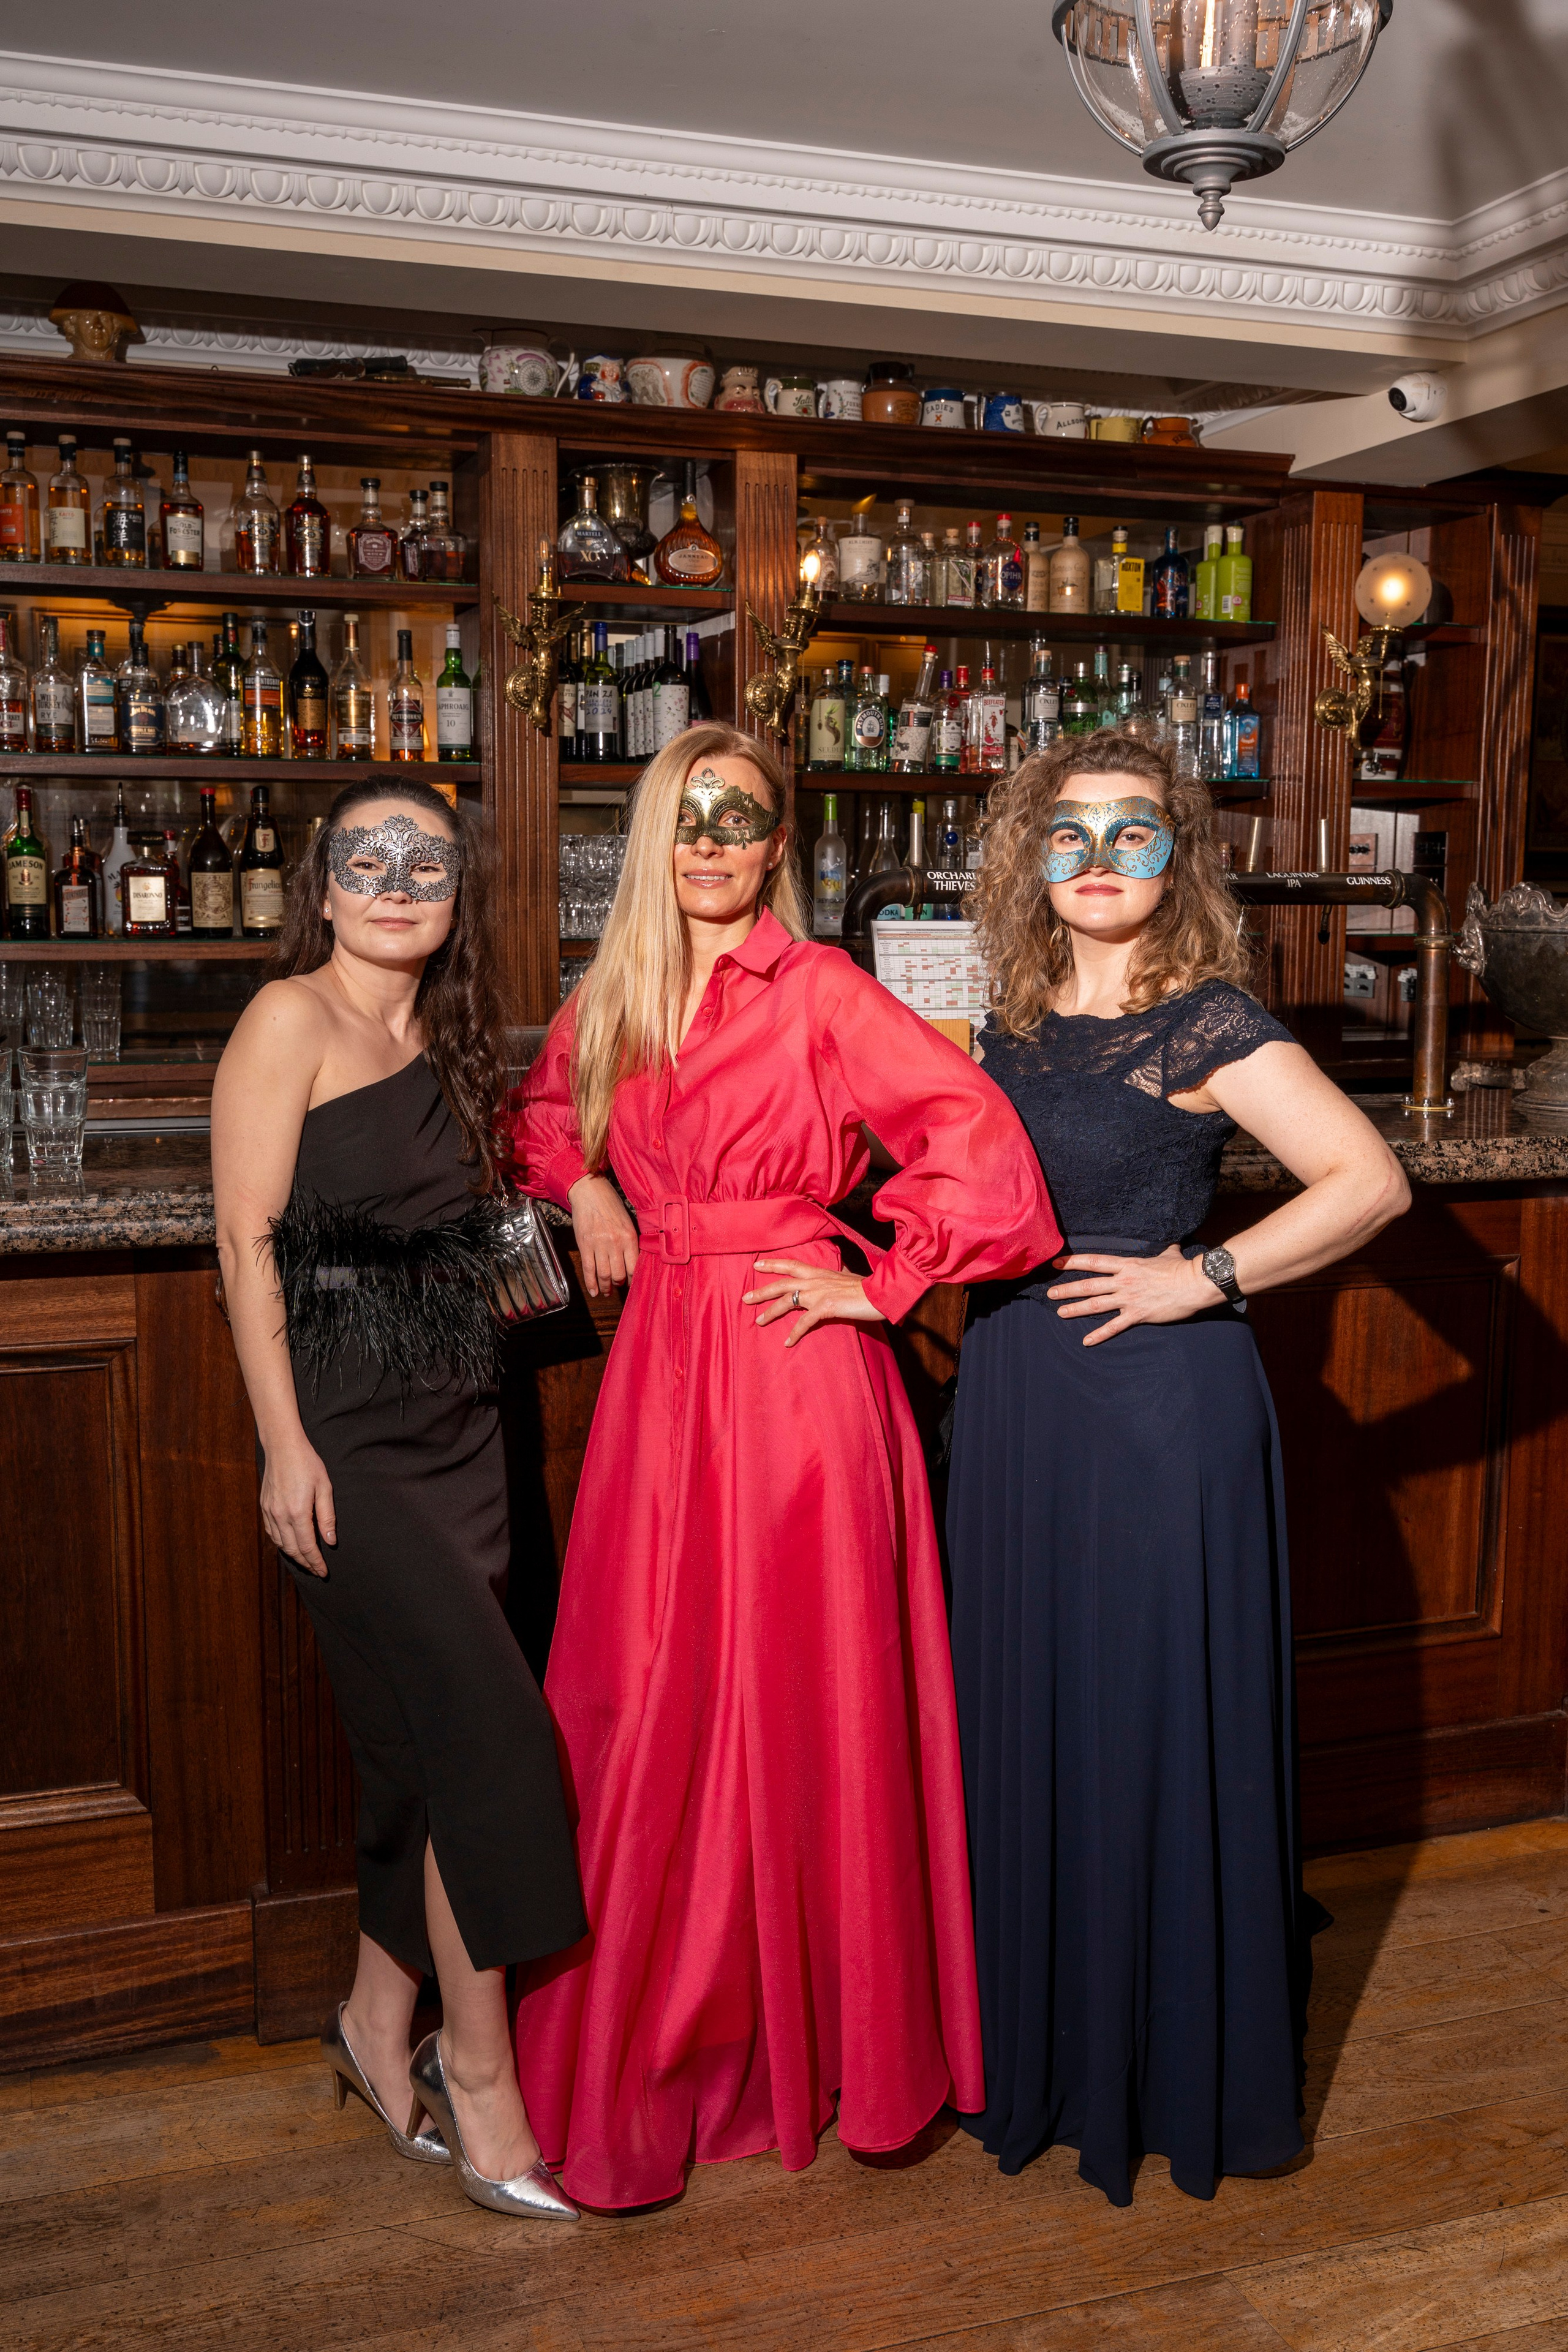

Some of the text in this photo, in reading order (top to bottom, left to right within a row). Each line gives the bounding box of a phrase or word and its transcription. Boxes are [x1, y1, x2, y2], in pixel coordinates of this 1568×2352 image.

[112, 511, 129, 548] 海洋
[580, 549, 599, 562] XO
[1121, 562, 1141, 572] HOXTON
[1000, 571, 1022, 580] OPIHR
[245, 676, 280, 685] AUCNTOSHAN
[37, 699, 61, 709] TURKEY
[857, 710, 881, 729] PLYMOUTH
[9, 860, 43, 870] JAMESON
[933, 880, 976, 891] THIEVES
[1286, 878, 1302, 888] IPA
[1346, 876, 1392, 885] GUINNESS
